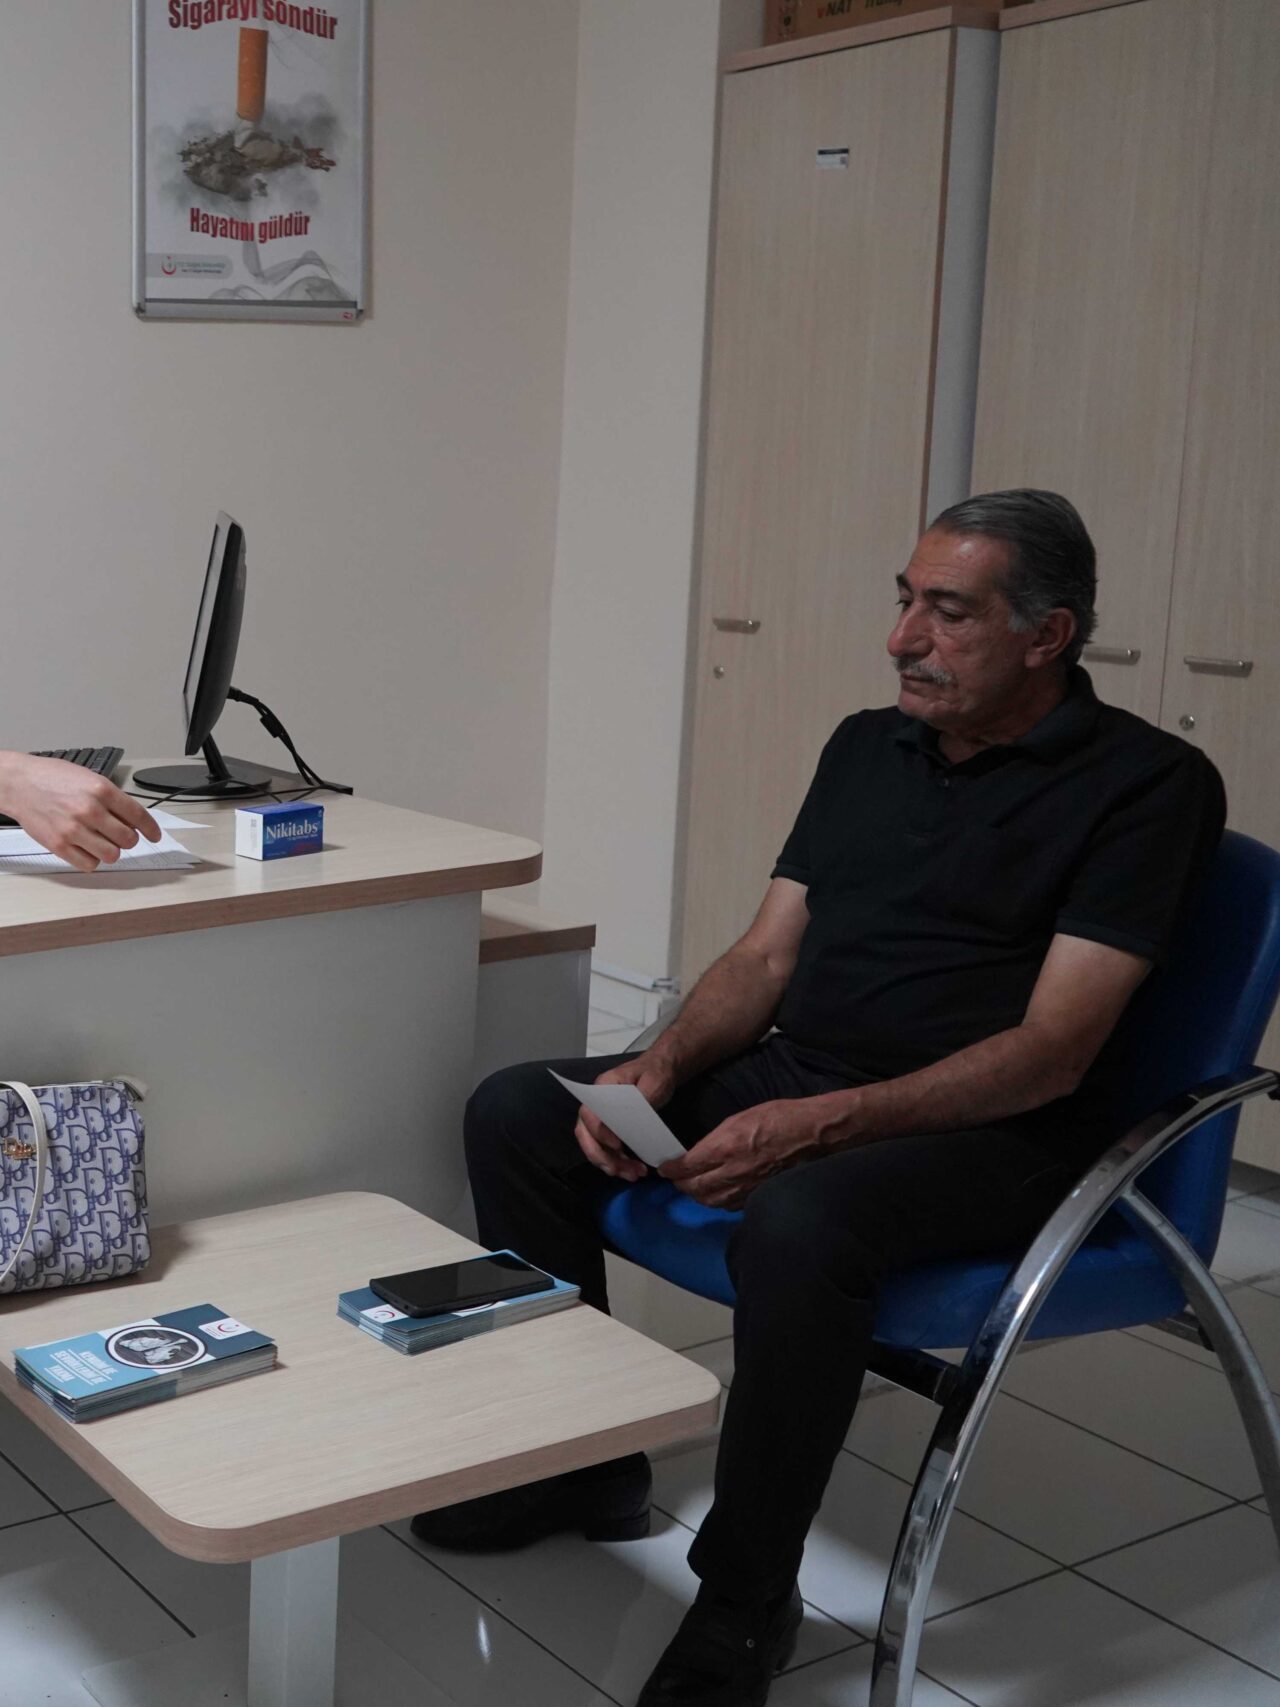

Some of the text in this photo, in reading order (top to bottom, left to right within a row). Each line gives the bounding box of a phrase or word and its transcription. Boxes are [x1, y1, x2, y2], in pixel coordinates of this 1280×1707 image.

[190, 207, 310, 244] Hayatını güldür
[266, 819, 319, 839] Nikitabs
